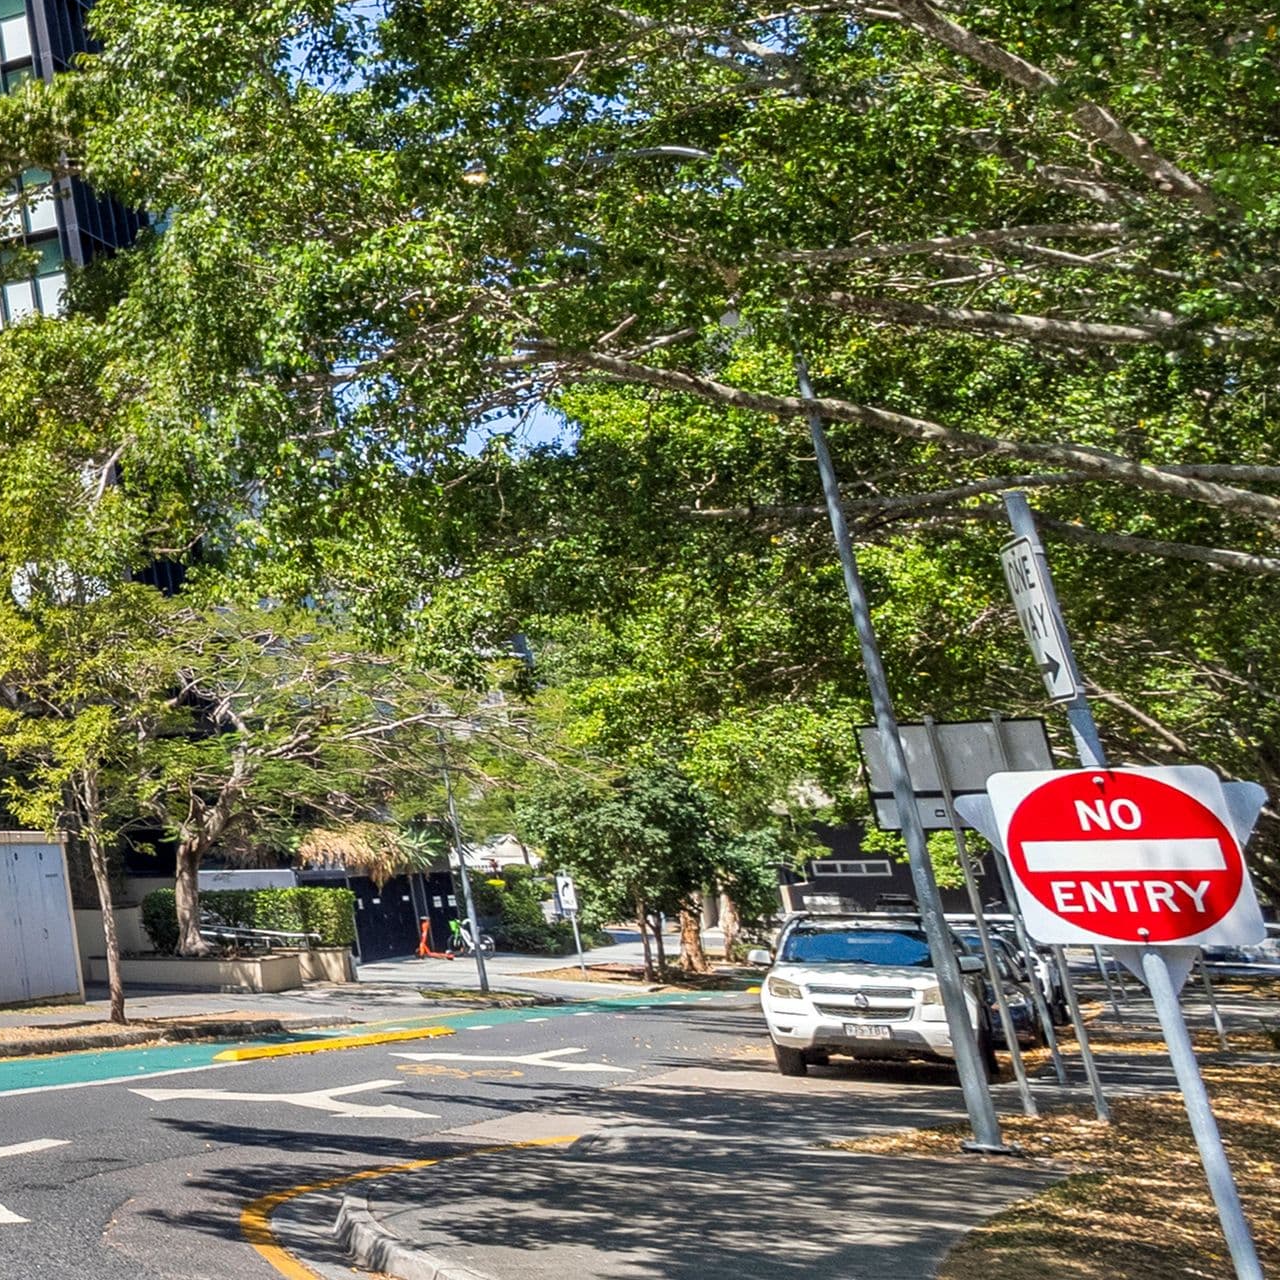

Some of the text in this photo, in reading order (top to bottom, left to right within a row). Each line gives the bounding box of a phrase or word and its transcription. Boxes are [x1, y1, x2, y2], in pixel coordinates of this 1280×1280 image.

[1008, 555, 1035, 595] ONE
[1073, 798, 1143, 832] NO
[1049, 880, 1211, 913] ENTRY
